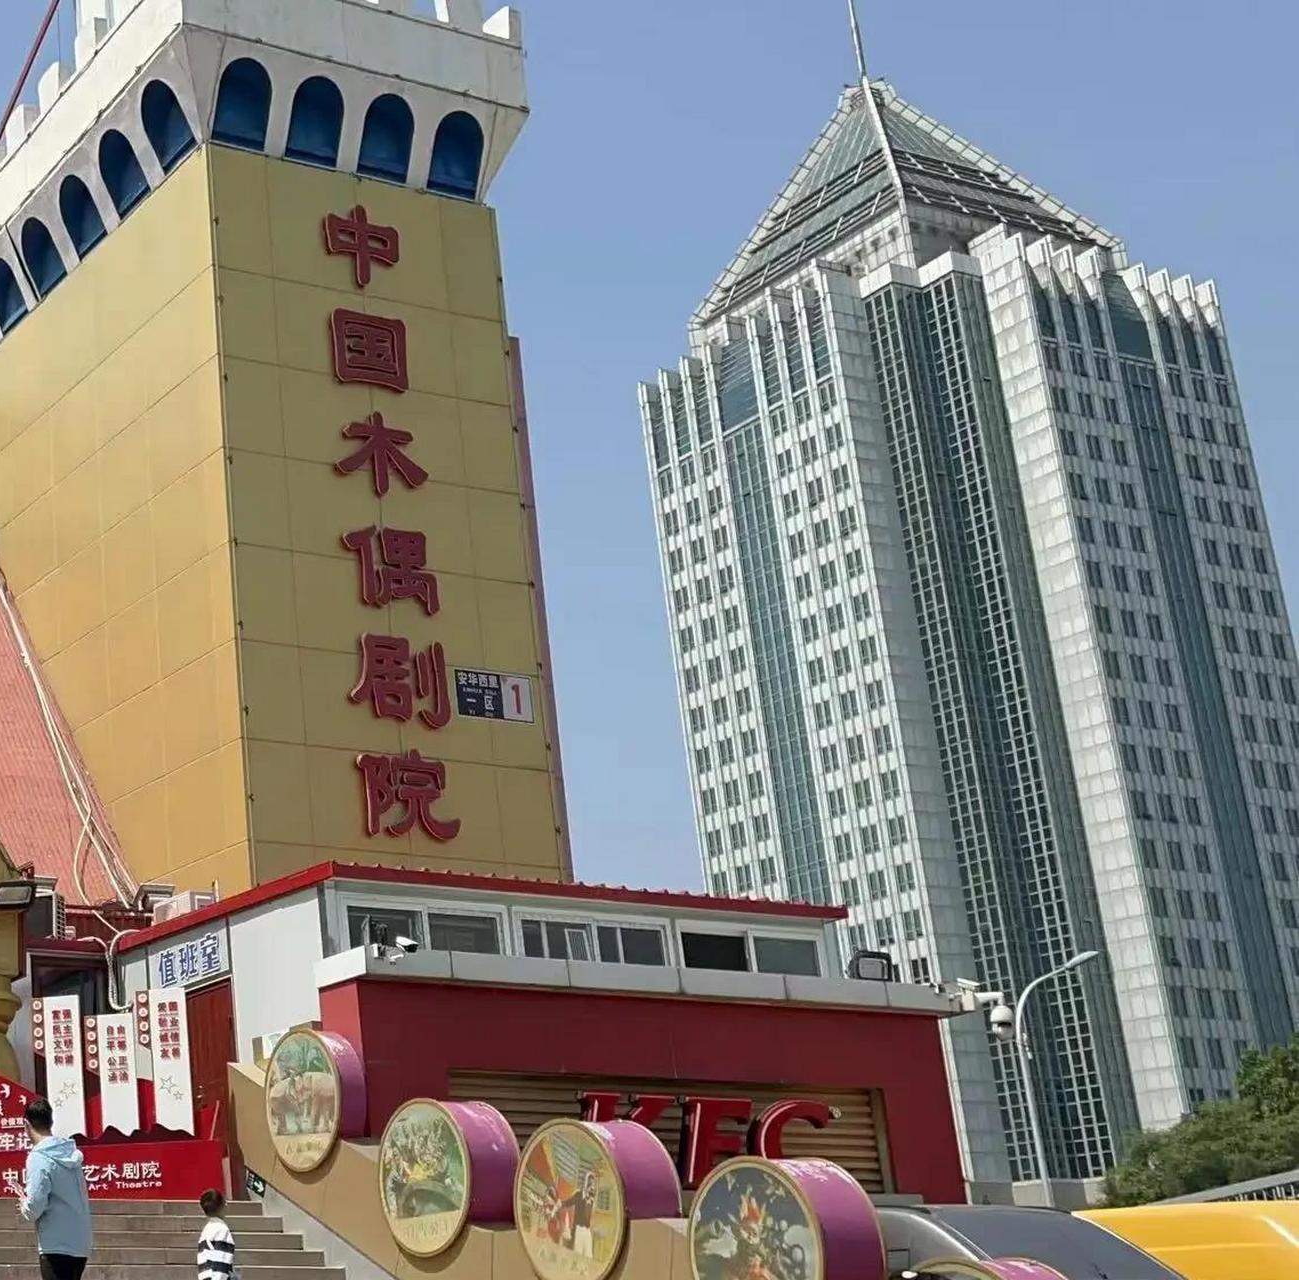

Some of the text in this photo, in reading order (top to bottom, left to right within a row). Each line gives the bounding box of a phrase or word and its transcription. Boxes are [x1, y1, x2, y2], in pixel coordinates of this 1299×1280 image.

[324, 204, 462, 840] 中国木偶剧院
[457, 671, 500, 689] 安华西里
[511, 684, 523, 715] 1
[158, 932, 221, 987] 值班室
[53, 1025, 73, 1037] 民主
[107, 1055, 129, 1067] 公正
[82, 1161, 162, 1182] 艺术剧院
[88, 1182, 108, 1192] Art
